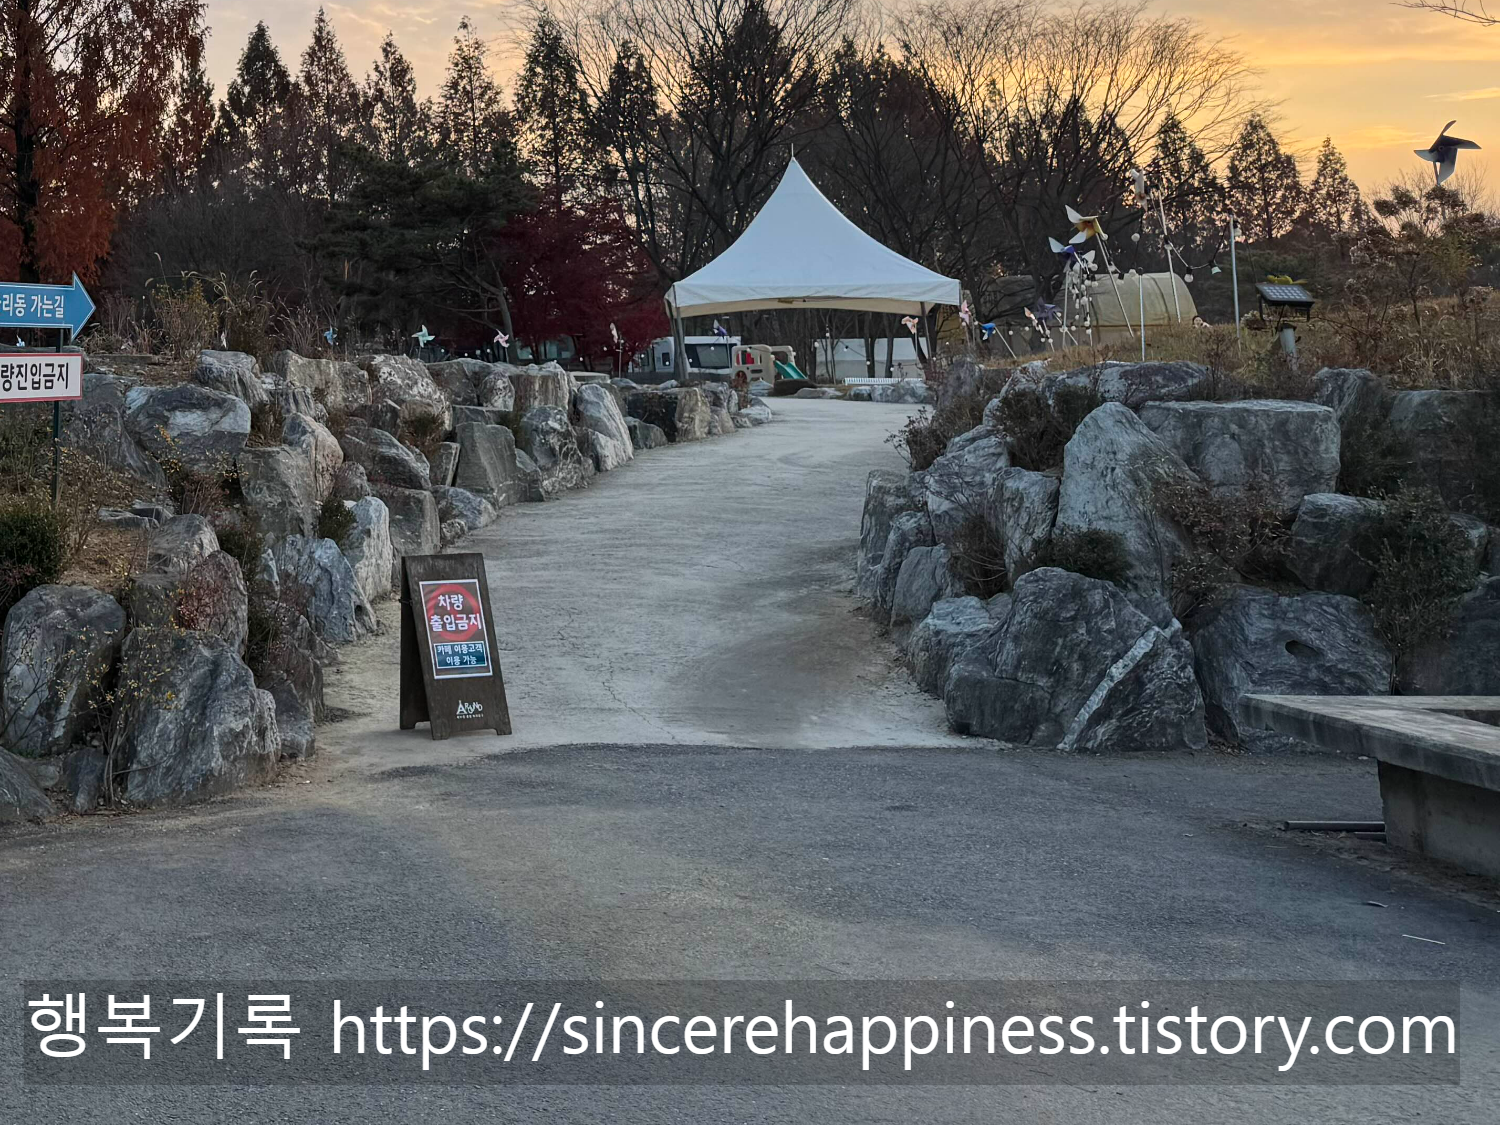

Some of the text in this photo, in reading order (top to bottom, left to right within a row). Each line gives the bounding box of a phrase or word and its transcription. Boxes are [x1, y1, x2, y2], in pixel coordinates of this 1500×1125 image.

[31, 295, 65, 318] 가는길
[438, 594, 464, 611] 차량
[430, 613, 482, 632] 출입금지
[437, 645, 452, 655] 카페
[446, 655, 477, 666] 이용 가능
